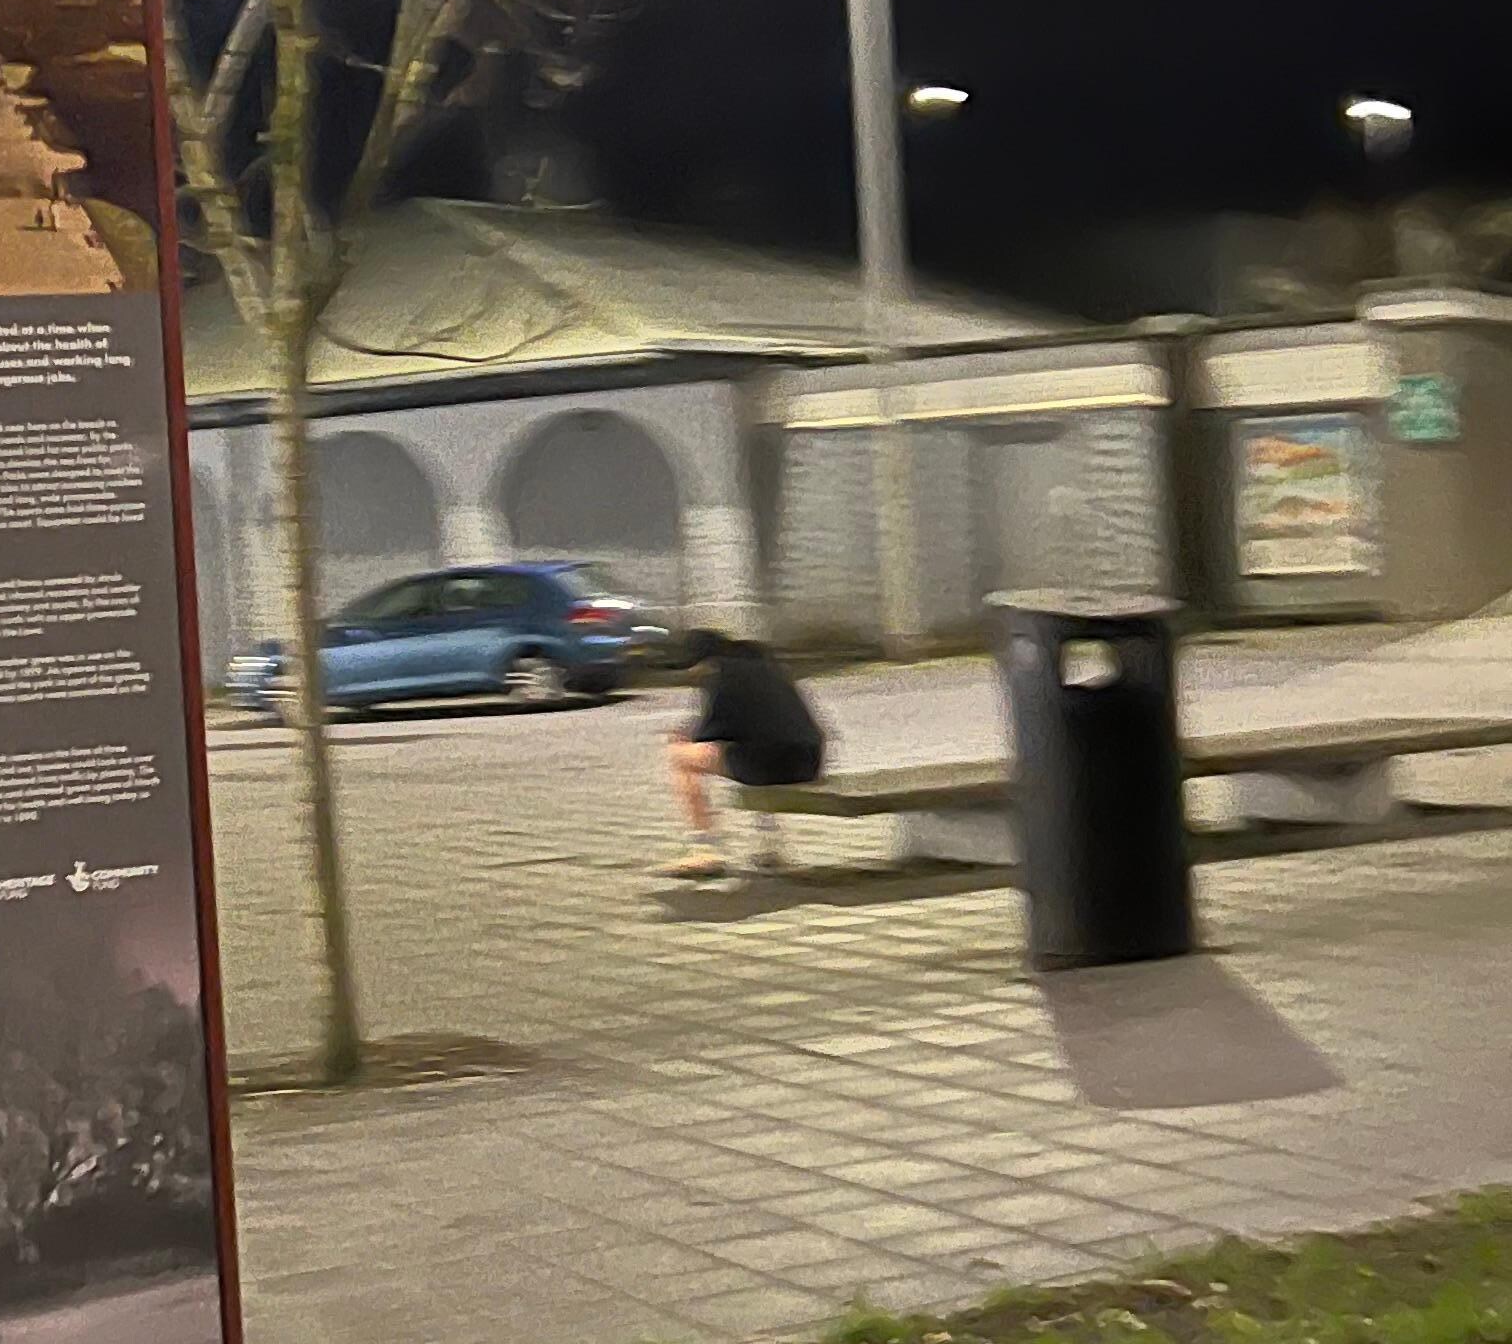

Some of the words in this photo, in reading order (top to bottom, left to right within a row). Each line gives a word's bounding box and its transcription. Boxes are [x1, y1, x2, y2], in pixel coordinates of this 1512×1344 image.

[48, 322, 75, 336] time
[33, 339, 52, 351] the
[55, 337, 92, 350] health
[95, 337, 108, 349] of
[26, 354, 49, 366] and
[52, 354, 103, 368] working
[105, 352, 132, 367] long
